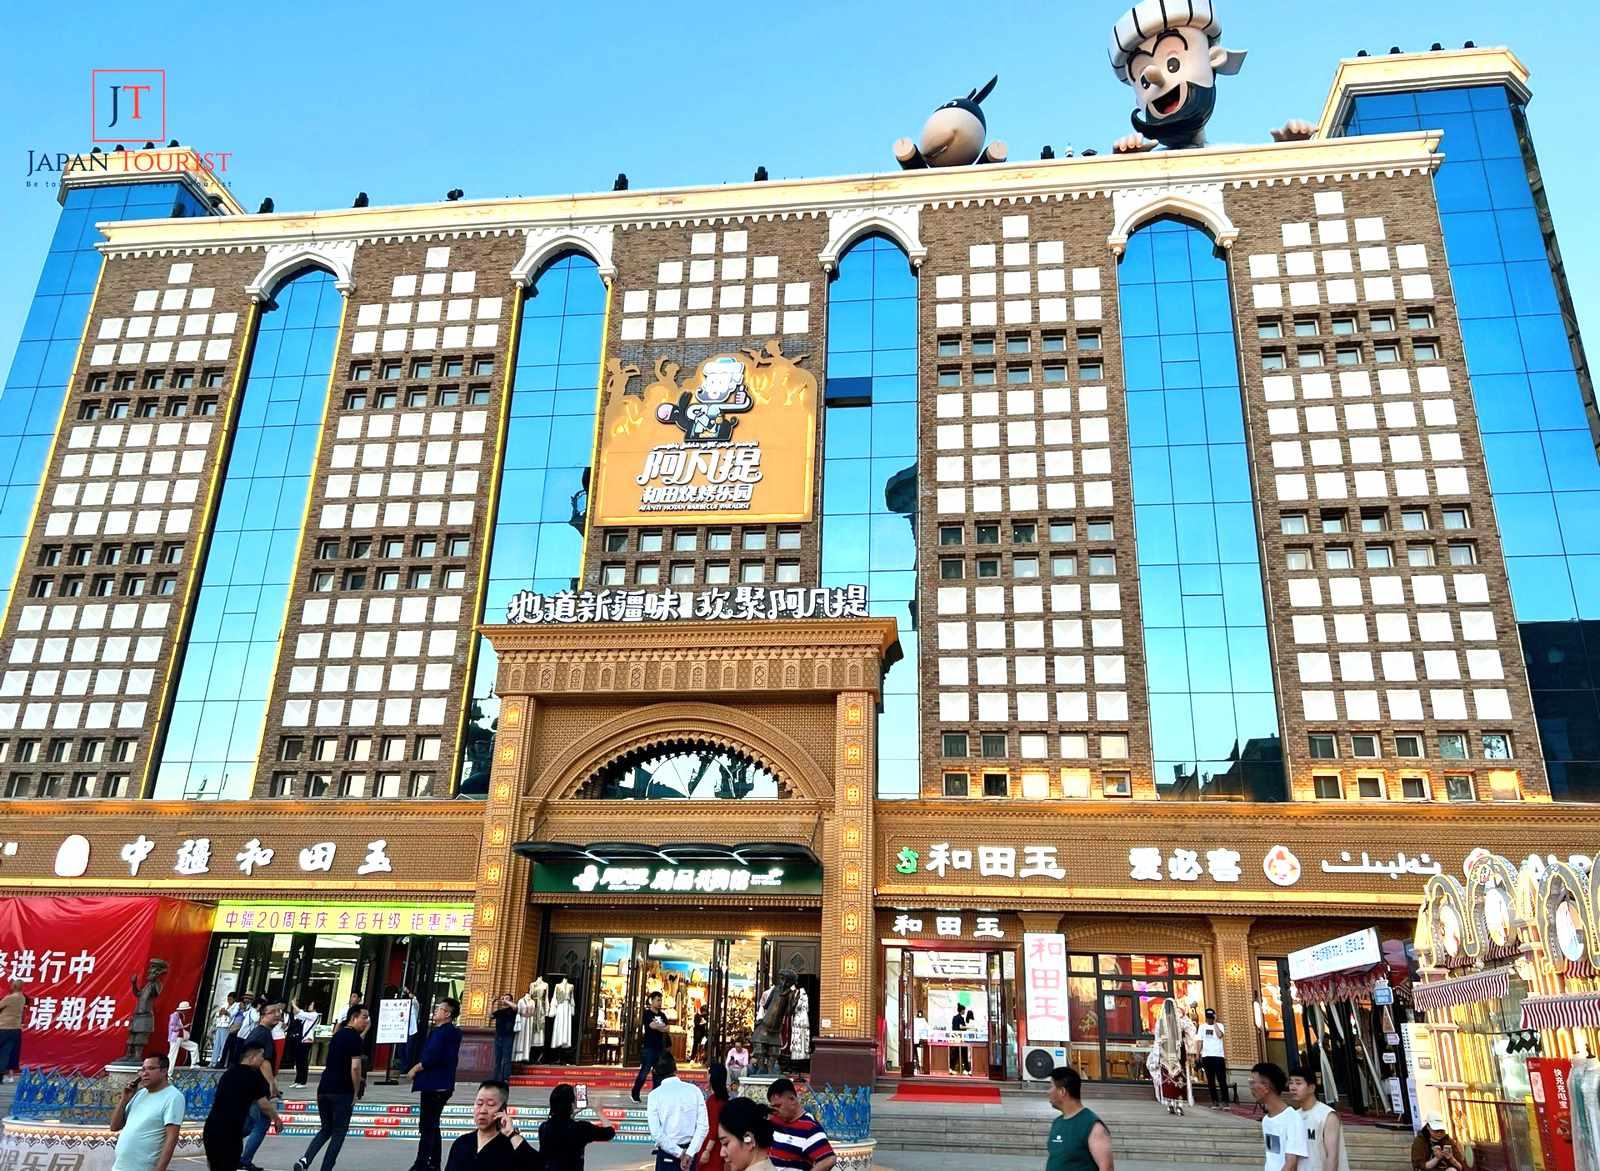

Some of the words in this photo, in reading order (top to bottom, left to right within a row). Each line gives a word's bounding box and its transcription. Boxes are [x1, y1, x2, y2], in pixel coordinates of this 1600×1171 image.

[636, 448, 763, 486] 阿凡提
[641, 484, 754, 505] 和田烧烤乐园
[506, 588, 680, 623] 地道新疆味
[695, 584, 869, 620] 欢聚阿凡提
[121, 835, 392, 876] 中疆和田玉
[925, 842, 1066, 880] 和田玉
[338, 911, 402, 930] 全店升级
[892, 914, 1005, 938] 和田玉
[1307, 1128, 1316, 1140] M
